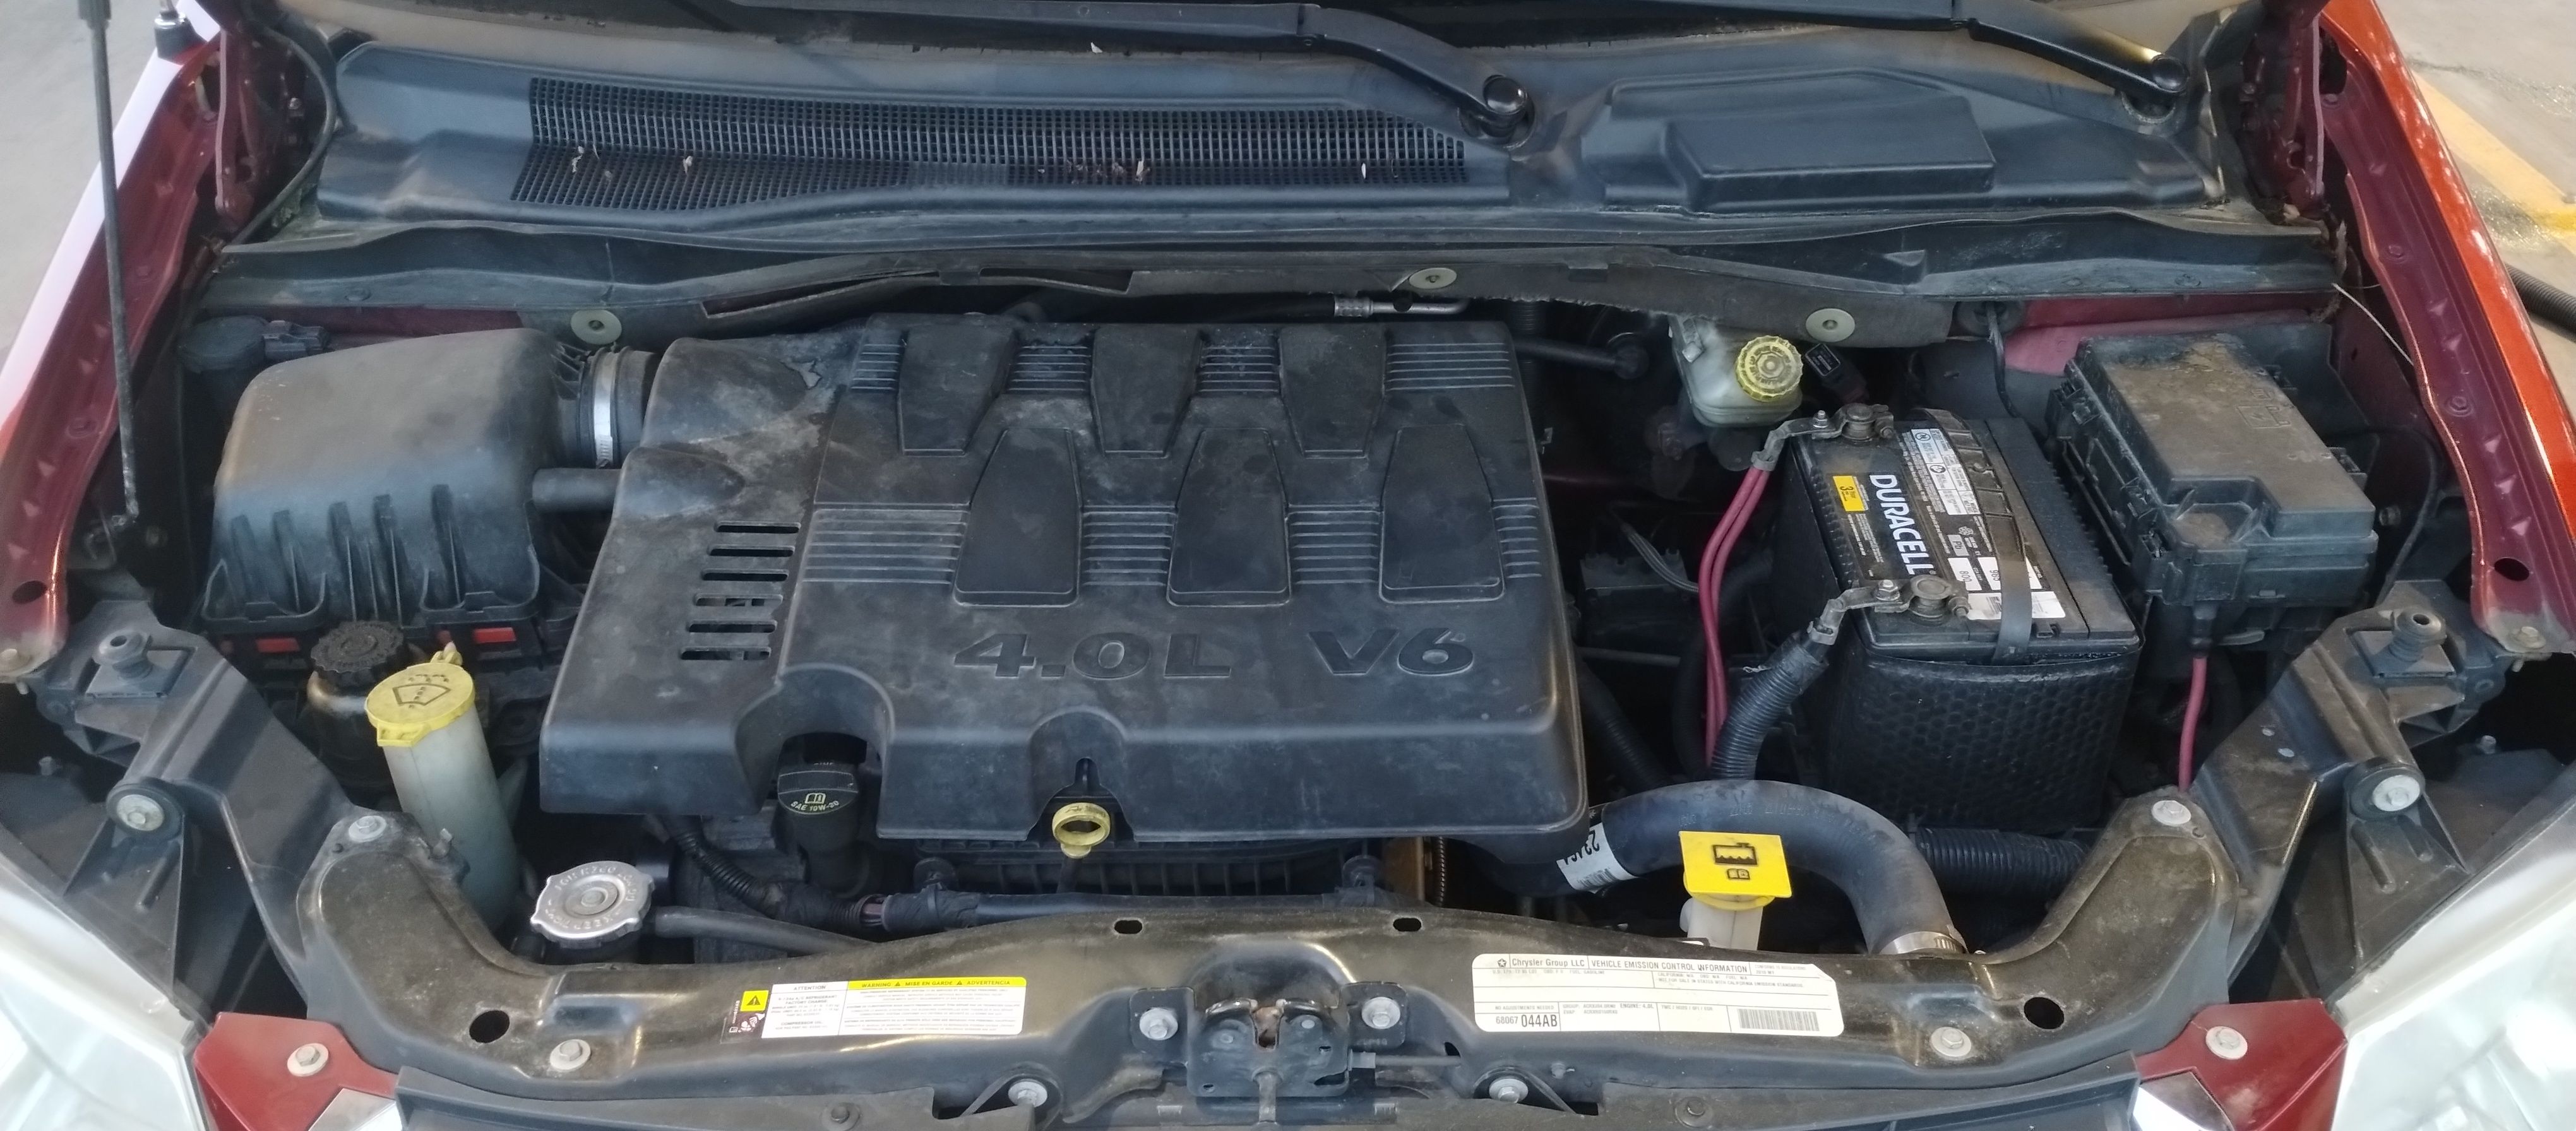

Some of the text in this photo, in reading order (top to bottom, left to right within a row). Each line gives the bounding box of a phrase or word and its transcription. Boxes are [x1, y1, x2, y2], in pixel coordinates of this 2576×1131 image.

[1869, 474, 1935, 576] DURACELL
[1952, 541, 1963, 549] Pb
[1959, 571, 1972, 581] 800
[953, 627, 1474, 679] 4.0L V6
[790, 801, 808, 811] SAE
[1512, 958, 1543, 967] Chrysler
[1546, 958, 1568, 968] Group
[1591, 960, 1747, 973] VEHICLE EMISSION CONTROL INFORMATION
[1496, 1014, 1558, 1027] 68067 044AB
